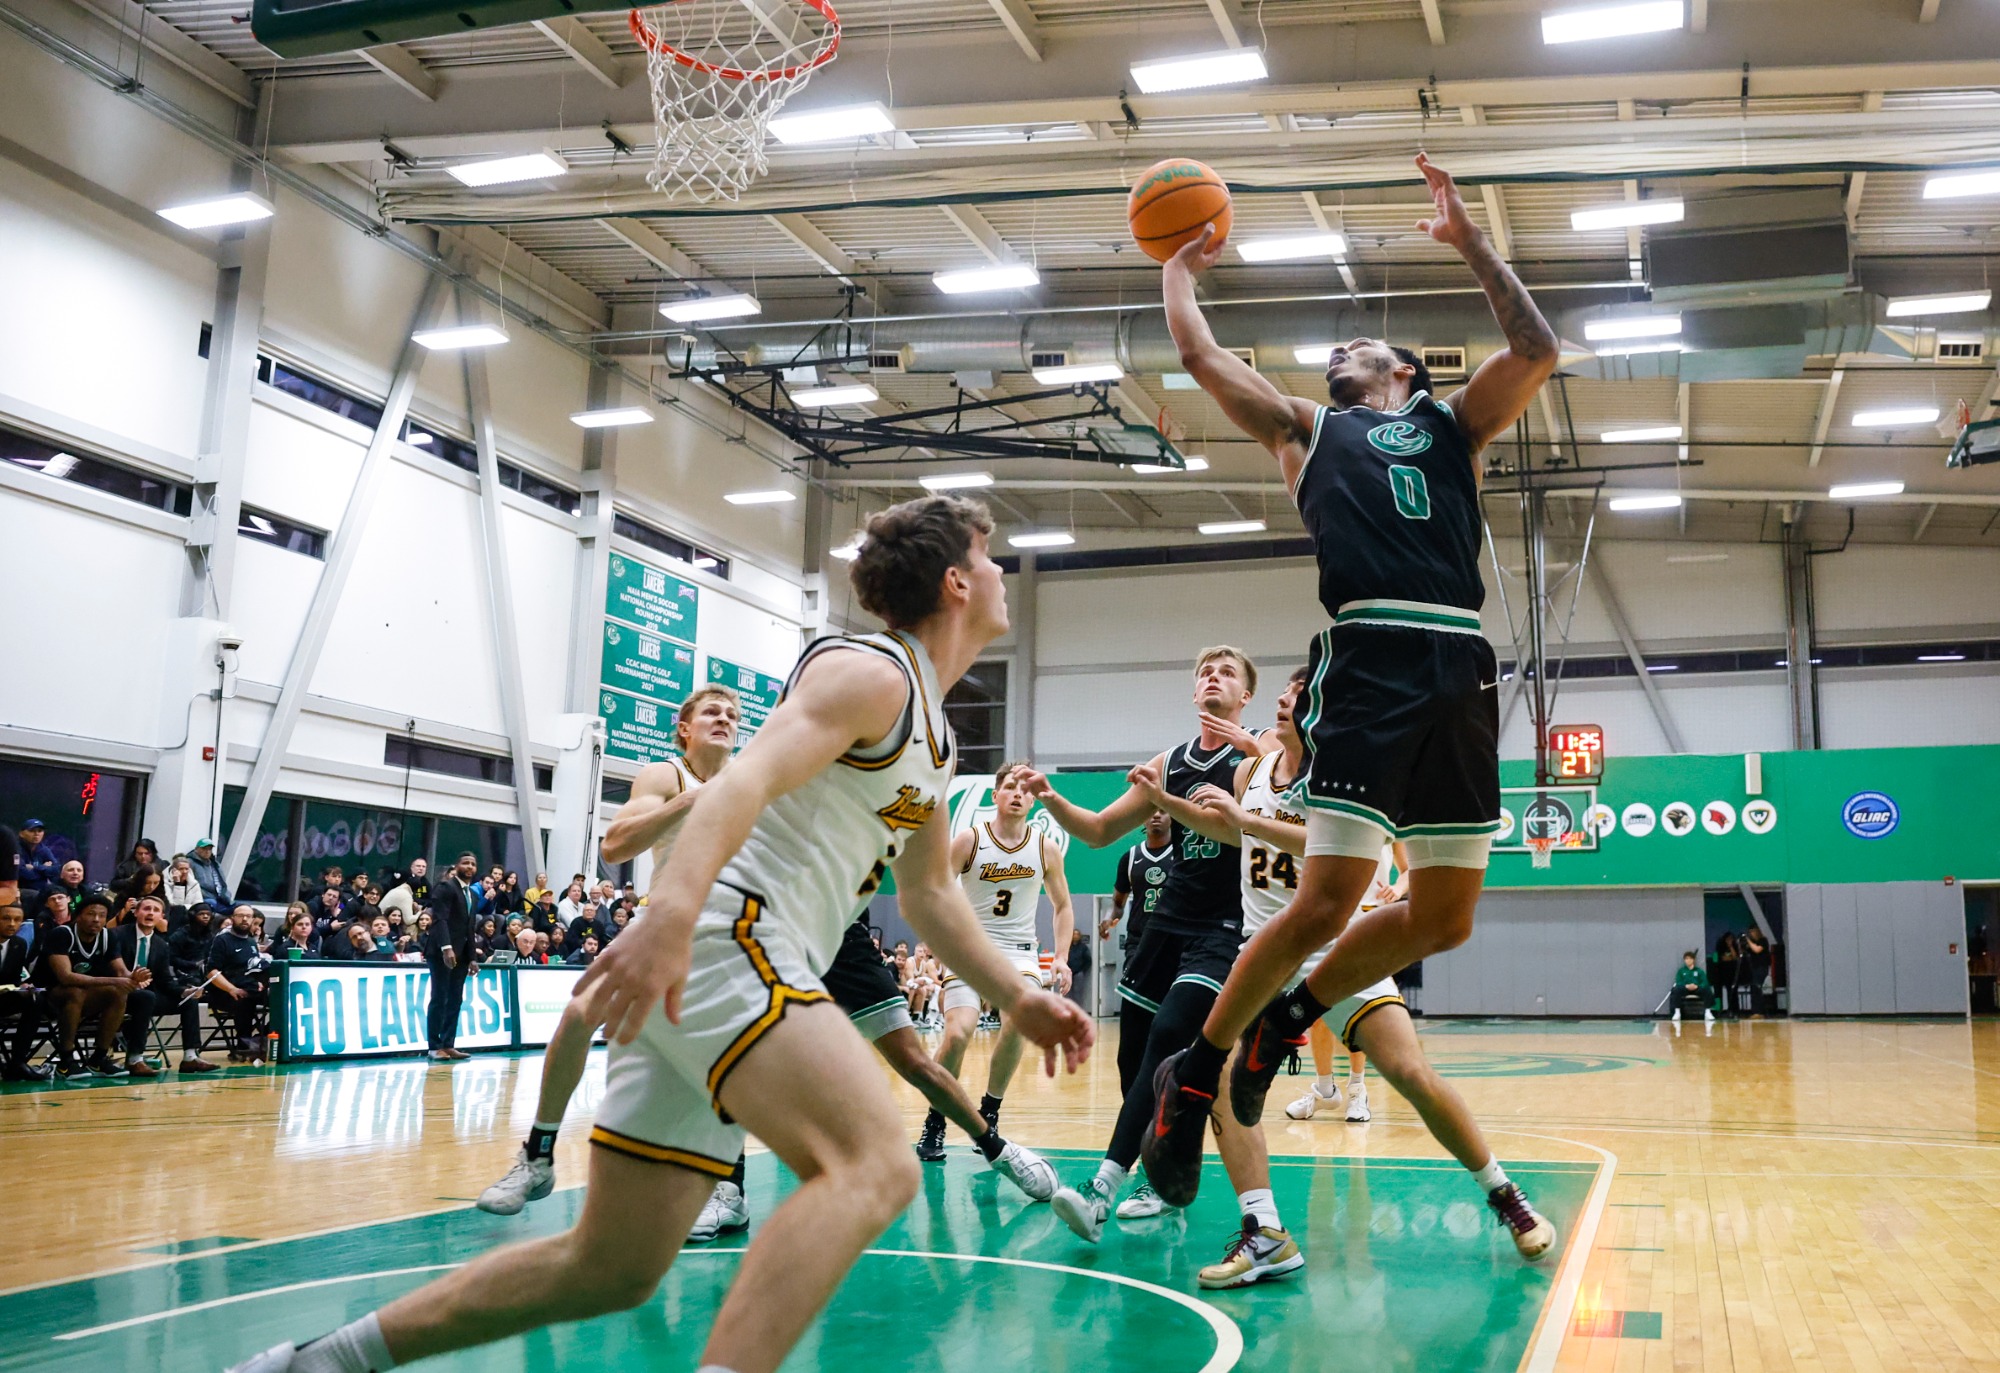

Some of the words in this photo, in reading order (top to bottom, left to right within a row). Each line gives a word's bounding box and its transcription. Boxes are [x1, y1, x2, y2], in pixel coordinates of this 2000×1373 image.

[1388, 464, 1431, 520] 0
[643, 572, 665, 596] LAKERS
[620, 592, 646, 608] NATIONAL
[645, 602, 684, 621] CHAMPIONSHIP
[627, 585, 641, 597] NAIA
[641, 591, 658, 603] MEN'S
[658, 597, 679, 611] SOCCER
[634, 607, 654, 620] ROUND
[654, 614, 662, 622] OF
[638, 639, 661, 661] LAKERS
[614, 664, 651, 681] TOURNAMENT
[651, 674, 681, 690] CHAMPIONS
[625, 657, 640, 668] CCAC
[640, 662, 658, 674] MEN'S
[657, 667, 672, 678] GOLF
[641, 681, 655, 692] 2021
[634, 705, 657, 727] LAKERS
[611, 729, 638, 742] NATIONAL
[622, 721, 636, 732] NAIA
[636, 725, 653, 736] MEN'S
[653, 729, 668, 739] GOLF
[611, 738, 649, 754] TOURNAMENT
[1557, 732, 1600, 751] 11:25
[1562, 751, 1591, 775] 27
[1852, 811, 1891, 824] GLIAC
[979, 862, 1036, 881] Huskies
[1251, 848, 1298, 890] 24
[993, 889, 1012, 917] 3
[1144, 887, 1162, 913] 2
[290, 979, 346, 1056] GO
[358, 968, 513, 1050] LAKRS!
